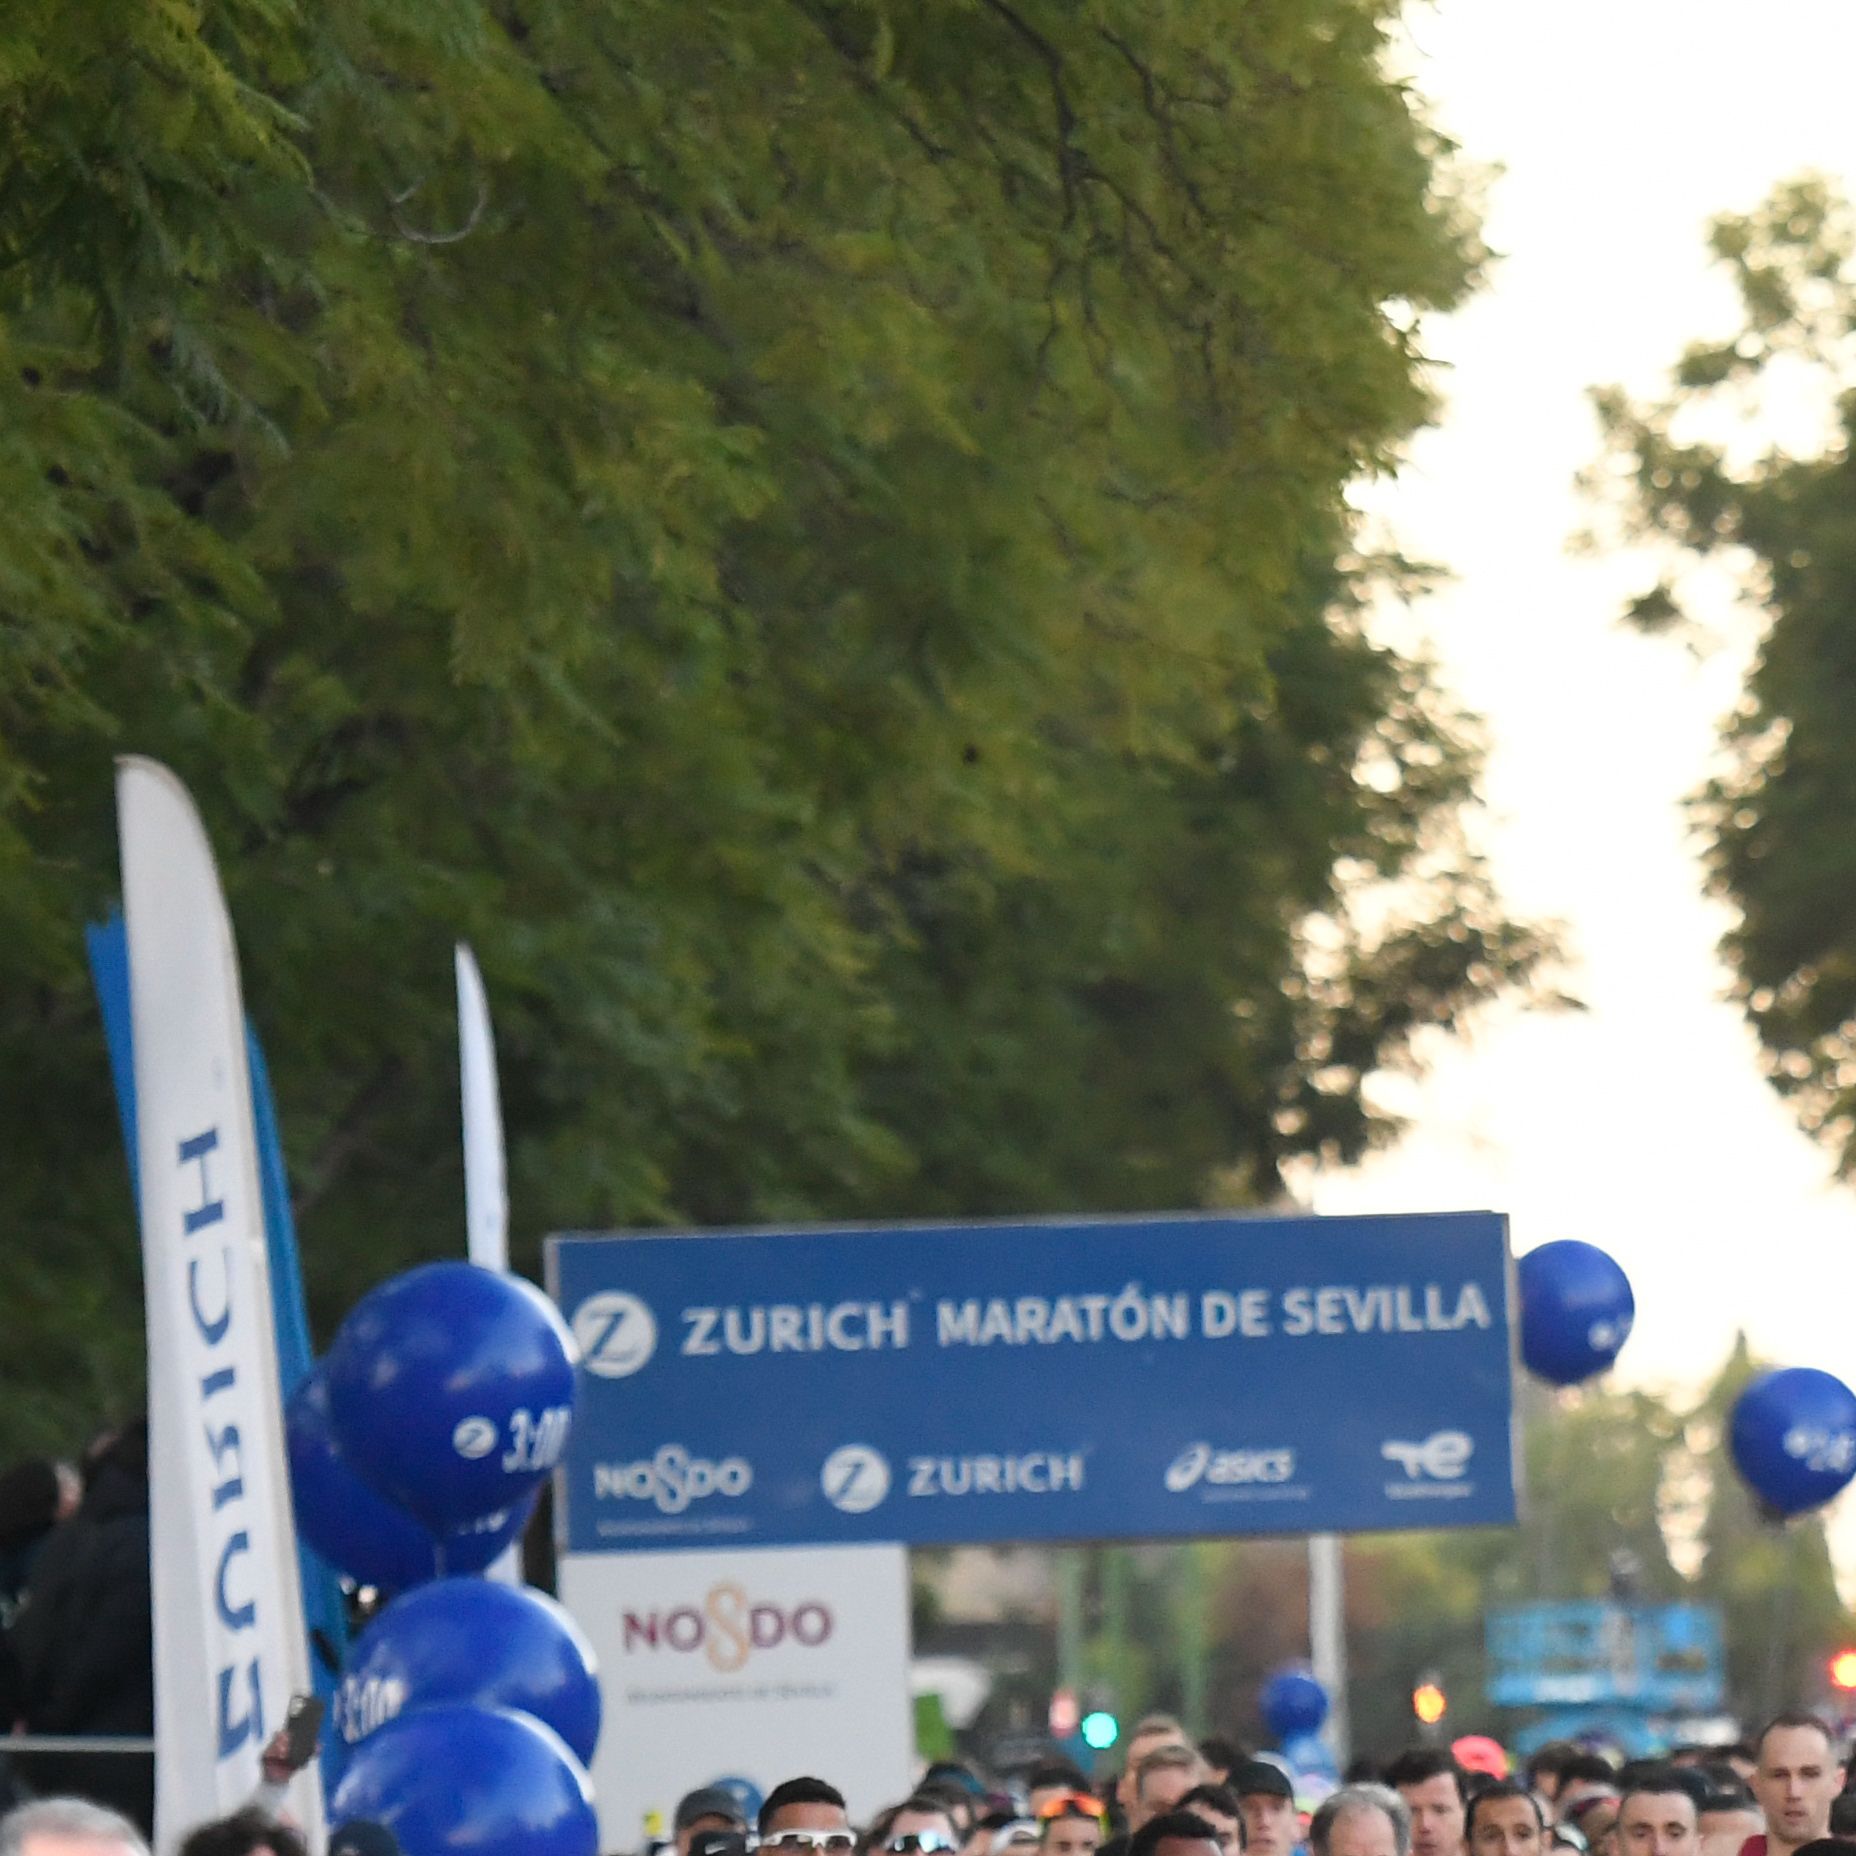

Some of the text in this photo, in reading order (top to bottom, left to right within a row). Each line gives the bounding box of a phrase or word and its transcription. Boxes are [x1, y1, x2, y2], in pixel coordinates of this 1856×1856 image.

[681, 1300, 910, 1356] ZURICH
[936, 1281, 1190, 1347] MARATÓN
[1202, 1289, 1270, 1339] DE
[1281, 1281, 1492, 1337] SEVILLA
[907, 1451, 1085, 1497] ZURICH
